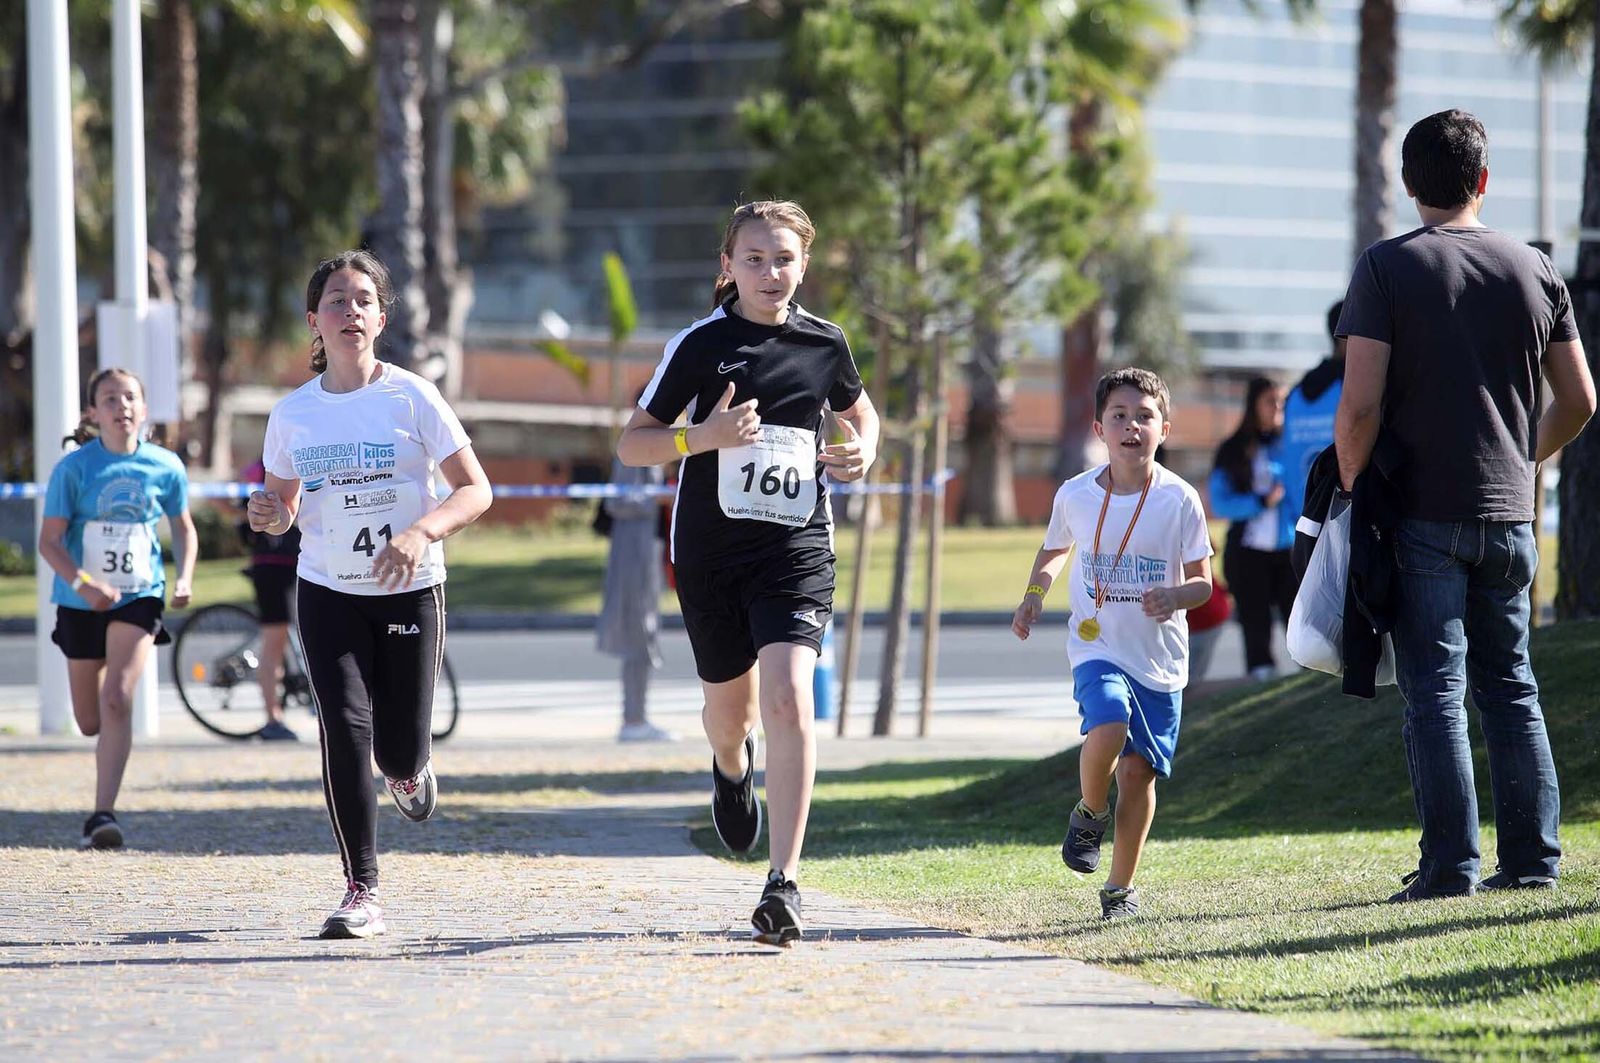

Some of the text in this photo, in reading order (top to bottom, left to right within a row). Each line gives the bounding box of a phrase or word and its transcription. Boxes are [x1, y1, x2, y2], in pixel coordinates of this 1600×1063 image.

[364, 447, 395, 459] kilos
[376, 460, 395, 469] km
[331, 477, 363, 486] ATLANTIC
[740, 462, 801, 500] 160
[764, 510, 776, 518] tus
[777, 512, 807, 523] sentidos
[353, 523, 393, 557] 41
[102, 550, 134, 574] 38
[1139, 560, 1166, 572] kilos
[1148, 573, 1165, 583] km
[1105, 595, 1142, 603] ATLANTIC
[387, 623, 420, 634] FILA
